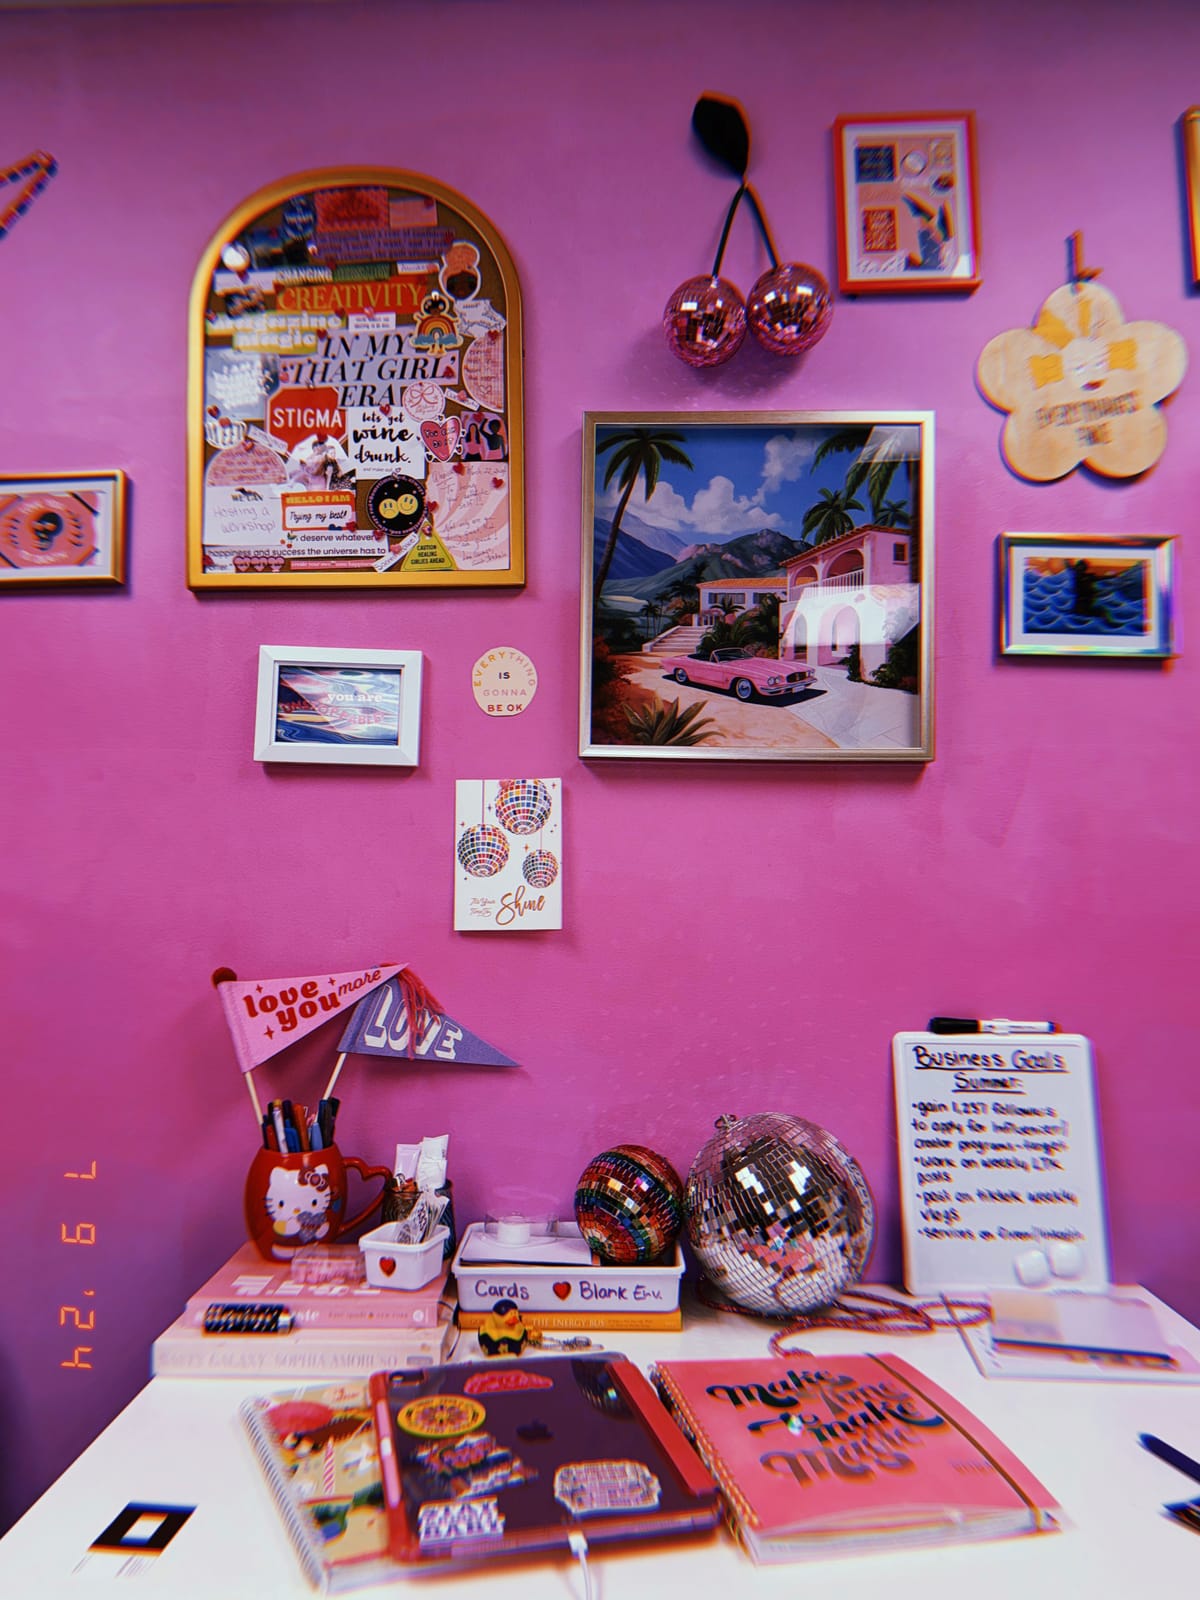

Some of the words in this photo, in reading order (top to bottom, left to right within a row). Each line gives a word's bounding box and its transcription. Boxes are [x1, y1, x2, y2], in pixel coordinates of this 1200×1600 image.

[279, 285, 424, 310] CREATIVITY
[322, 333, 359, 357] IN
[365, 333, 413, 356] MY
[339, 384, 396, 408] ERA
[272, 407, 342, 429] STIGMA
[388, 412, 405, 425] get
[353, 425, 414, 443] wine
[335, 533, 377, 541] whatever
[253, 549, 270, 557] and
[272, 549, 306, 557] success
[323, 547, 358, 555] universe
[359, 547, 375, 555] has
[377, 547, 386, 555] to
[498, 671, 511, 679] IS
[327, 693, 354, 704] you
[357, 693, 383, 703] are
[482, 688, 527, 697] GONNA
[487, 704, 503, 712] BE
[507, 703, 523, 712] OK
[495, 885, 546, 926] Shine
[242, 980, 320, 1019] love
[276, 990, 341, 1033] you
[338, 968, 382, 997] more
[364, 982, 463, 1060] LOVE
[912, 1045, 1006, 1068] Business
[475, 1279, 530, 1300] Cards
[579, 1280, 628, 1300] Blank
